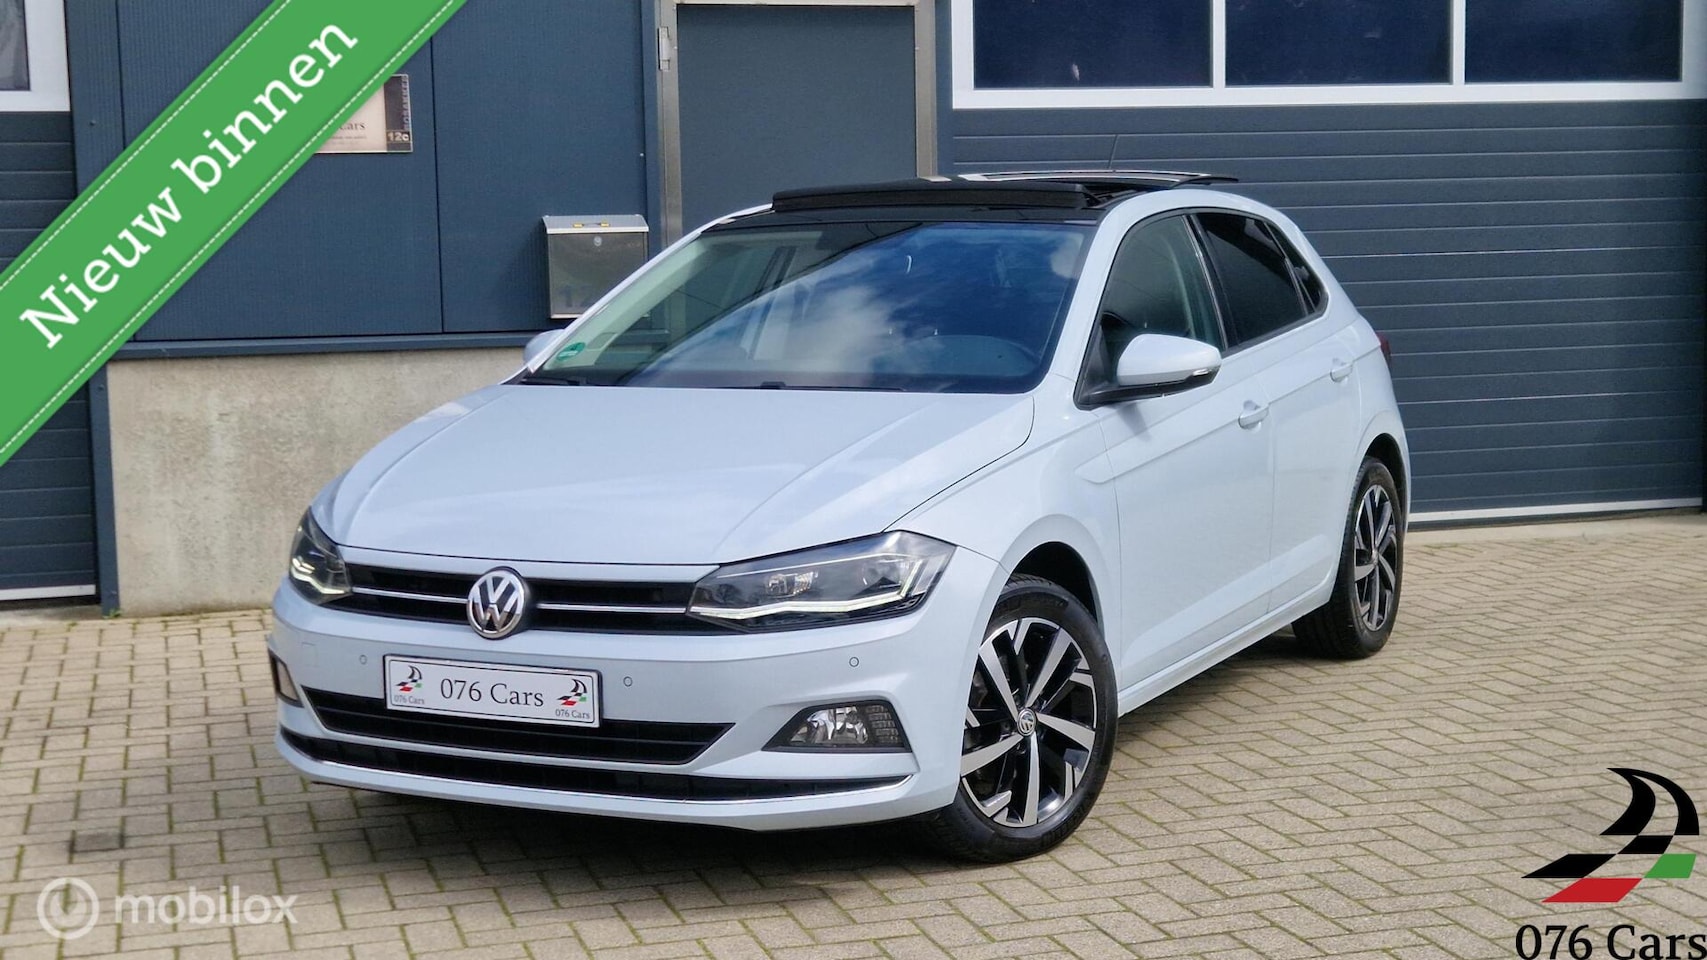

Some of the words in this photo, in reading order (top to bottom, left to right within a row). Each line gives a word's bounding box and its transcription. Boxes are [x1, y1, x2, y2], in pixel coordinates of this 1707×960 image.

[470, 573, 521, 634] VW
[393, 694, 408, 704] 076
[409, 695, 425, 705] Cars
[440, 678, 482, 702] 076
[490, 683, 544, 707] Cars
[555, 708, 570, 718] 076
[571, 709, 590, 720] Cars
